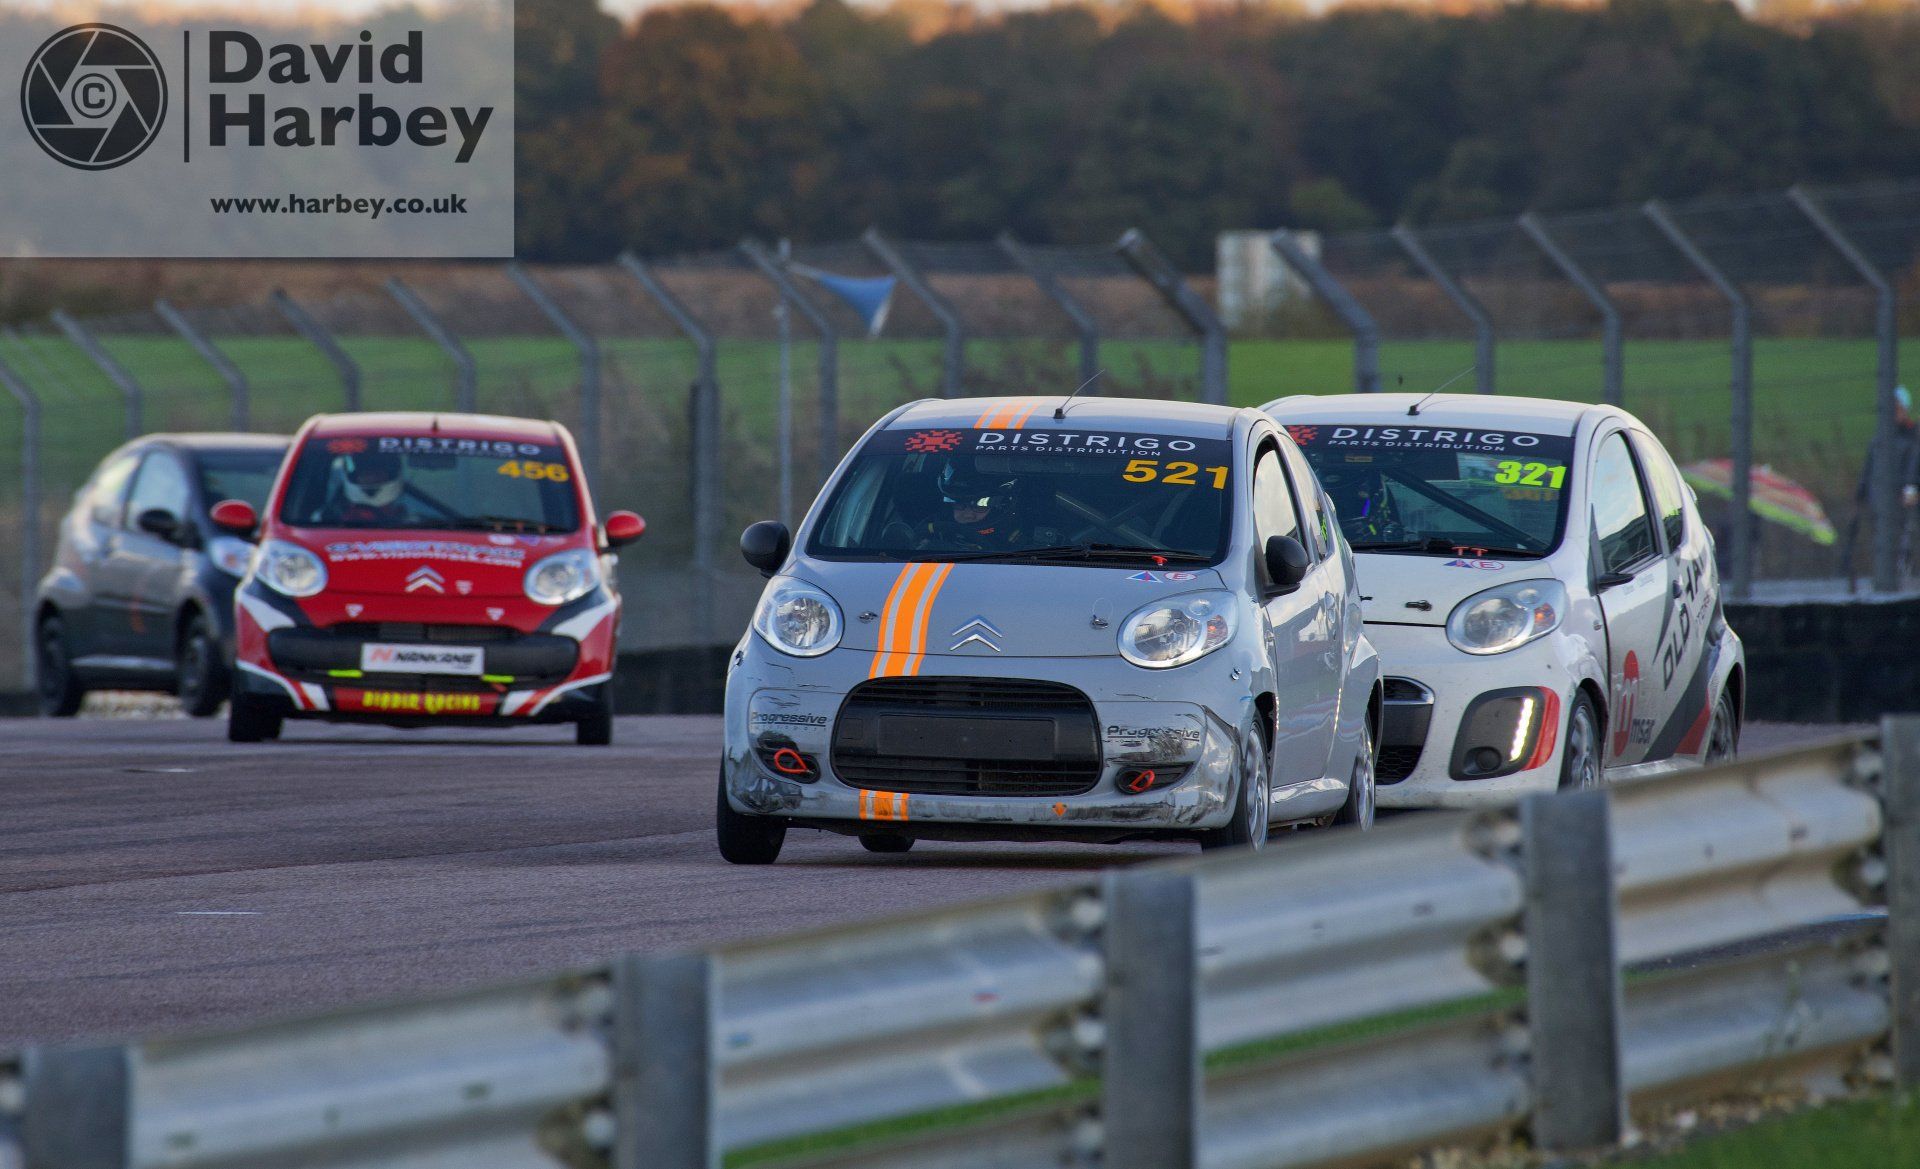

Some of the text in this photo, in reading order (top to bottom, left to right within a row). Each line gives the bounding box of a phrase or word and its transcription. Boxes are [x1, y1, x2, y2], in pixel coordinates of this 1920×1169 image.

[378, 437, 541, 456] DISTRIGO
[978, 432, 1197, 451] DISTRIGO
[1331, 428, 1540, 447] DISTRIGO
[1385, 441, 1505, 451] DISTRIBUTION
[1035, 446, 1162, 456] DISTRIBUTION
[497, 460, 570, 483] 456
[1122, 459, 1229, 490] 521
[1494, 461, 1568, 489] 321
